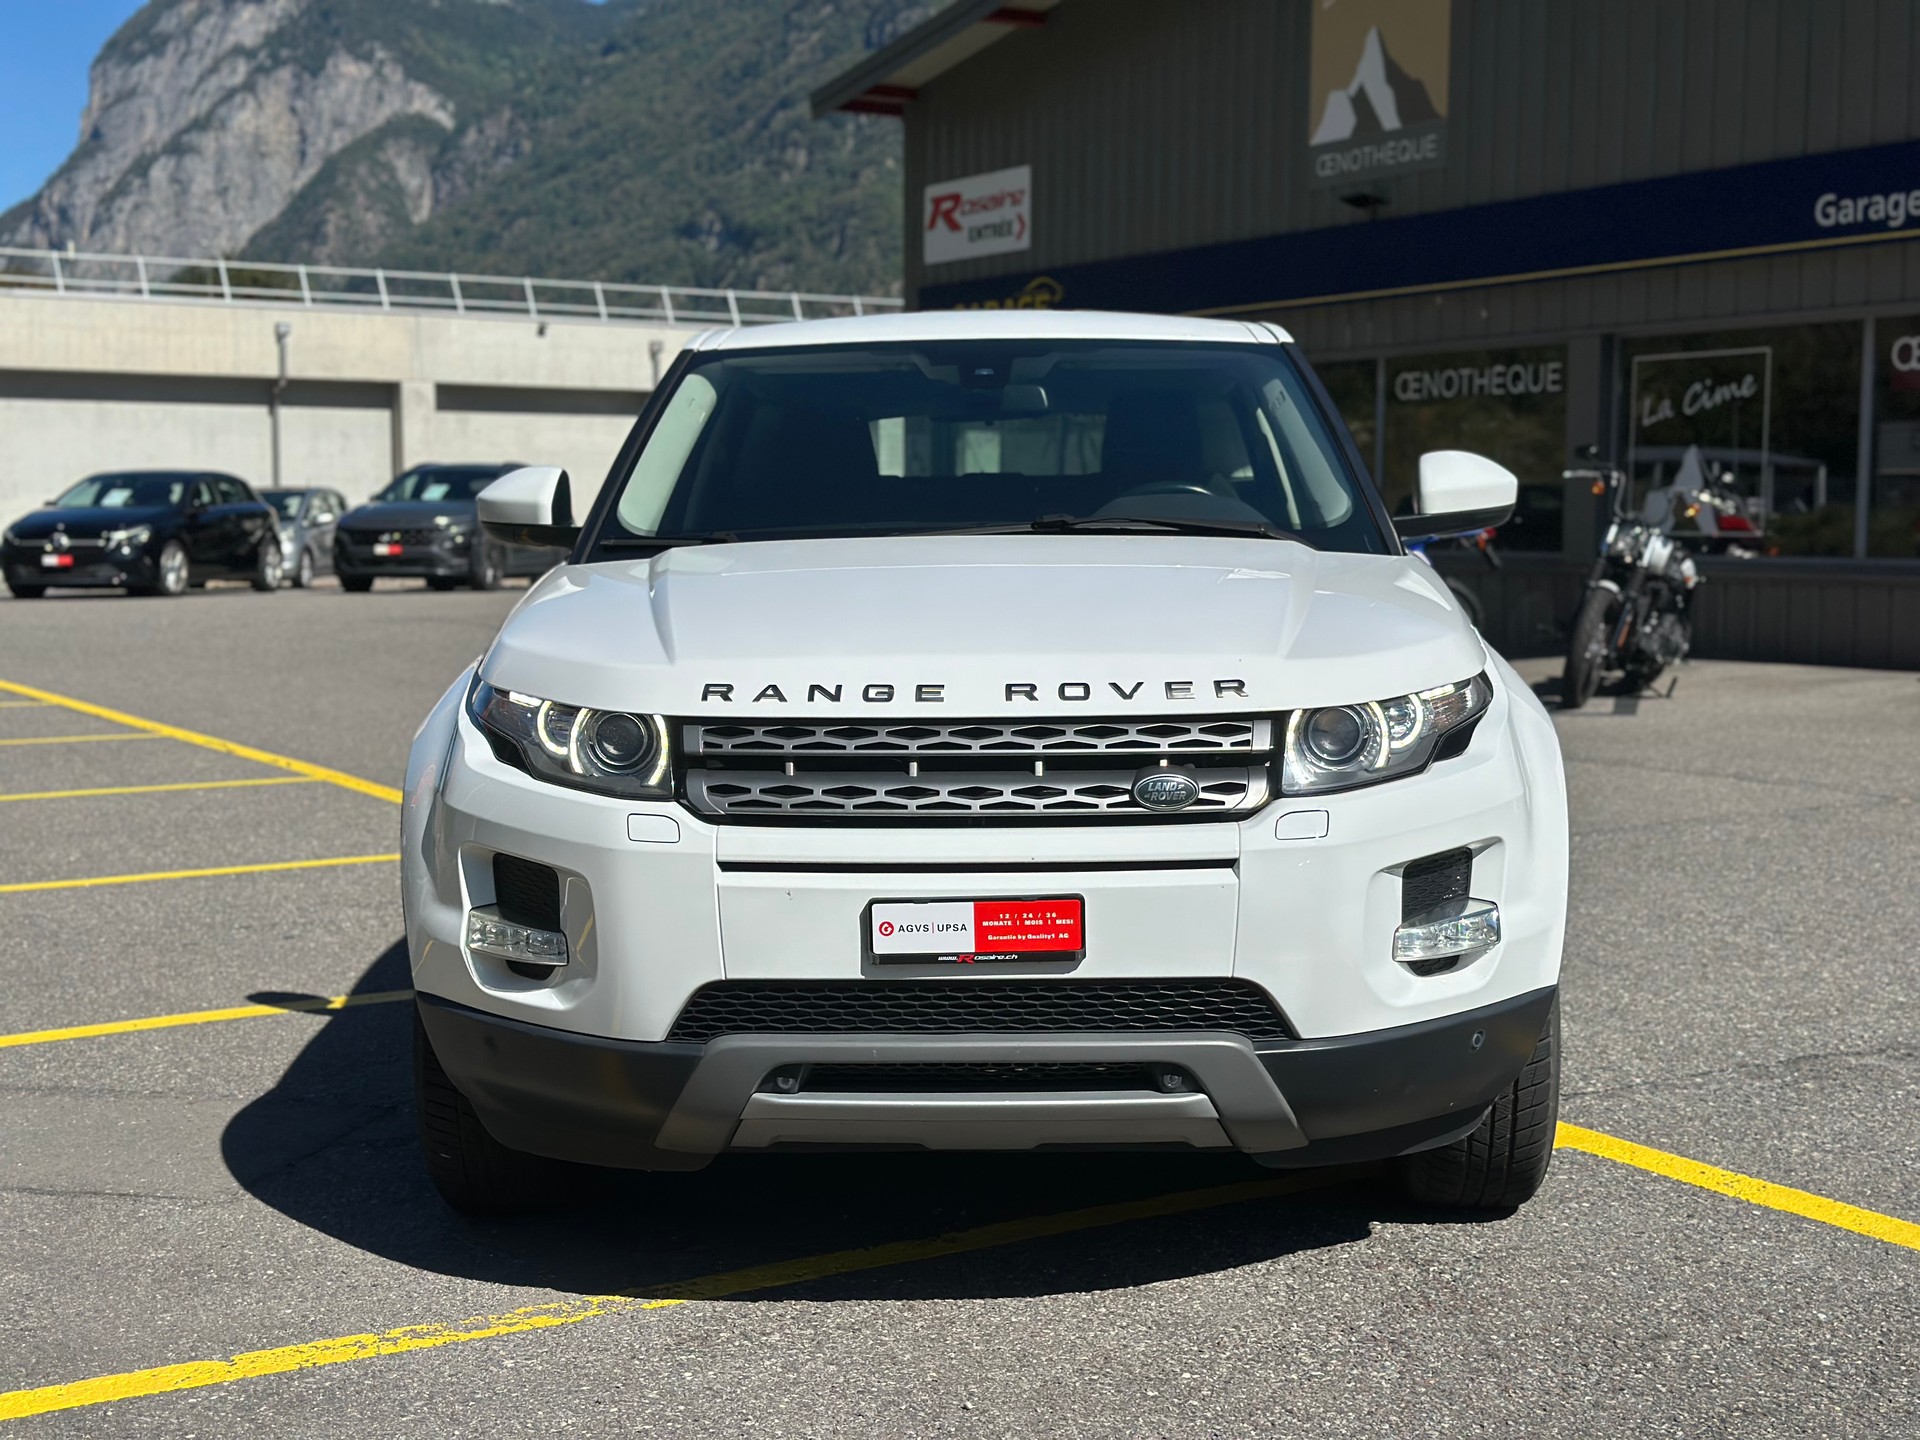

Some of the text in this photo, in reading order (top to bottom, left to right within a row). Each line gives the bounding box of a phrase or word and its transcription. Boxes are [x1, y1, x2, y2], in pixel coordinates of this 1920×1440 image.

[927, 189, 1026, 232] Rosaire
[1813, 189, 1920, 229] Garage
[1641, 372, 1759, 428] La Cime
[701, 679, 1250, 703] RANGE ROVER
[1147, 781, 1178, 792] LAND
[1150, 790, 1187, 801] ROVER
[898, 923, 968, 933] AGVS UPSA
[1018, 933, 1026, 941] by
